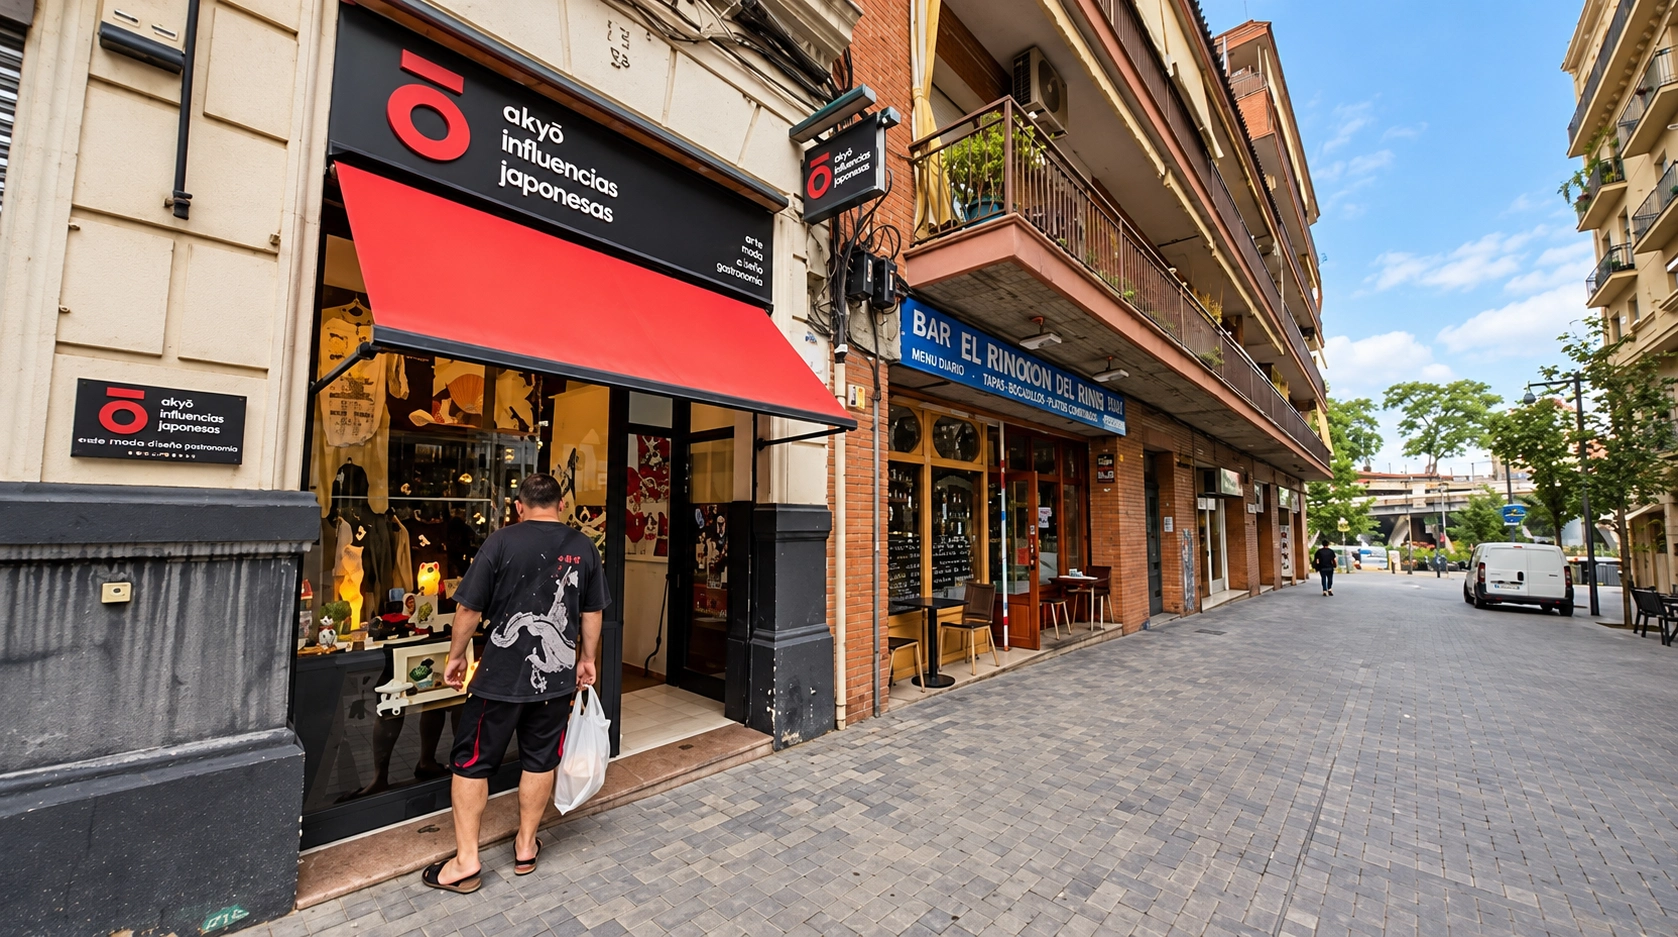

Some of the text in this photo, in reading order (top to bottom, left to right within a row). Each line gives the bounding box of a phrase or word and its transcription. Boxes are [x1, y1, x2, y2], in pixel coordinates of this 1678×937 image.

[502, 103, 564, 146] akyō
[501, 129, 619, 198] influencias
[499, 160, 614, 224] japonesas
[741, 245, 763, 262] moda
[745, 235, 763, 250] arte
[911, 347, 938, 367] MENU
[938, 357, 965, 376] DIARIO
[912, 308, 951, 348] BAR
[961, 331, 982, 365] EL
[1056, 373, 1075, 400] DEL
[160, 409, 225, 423] influencias
[109, 438, 145, 448] moda
[147, 439, 182, 450] diseño
